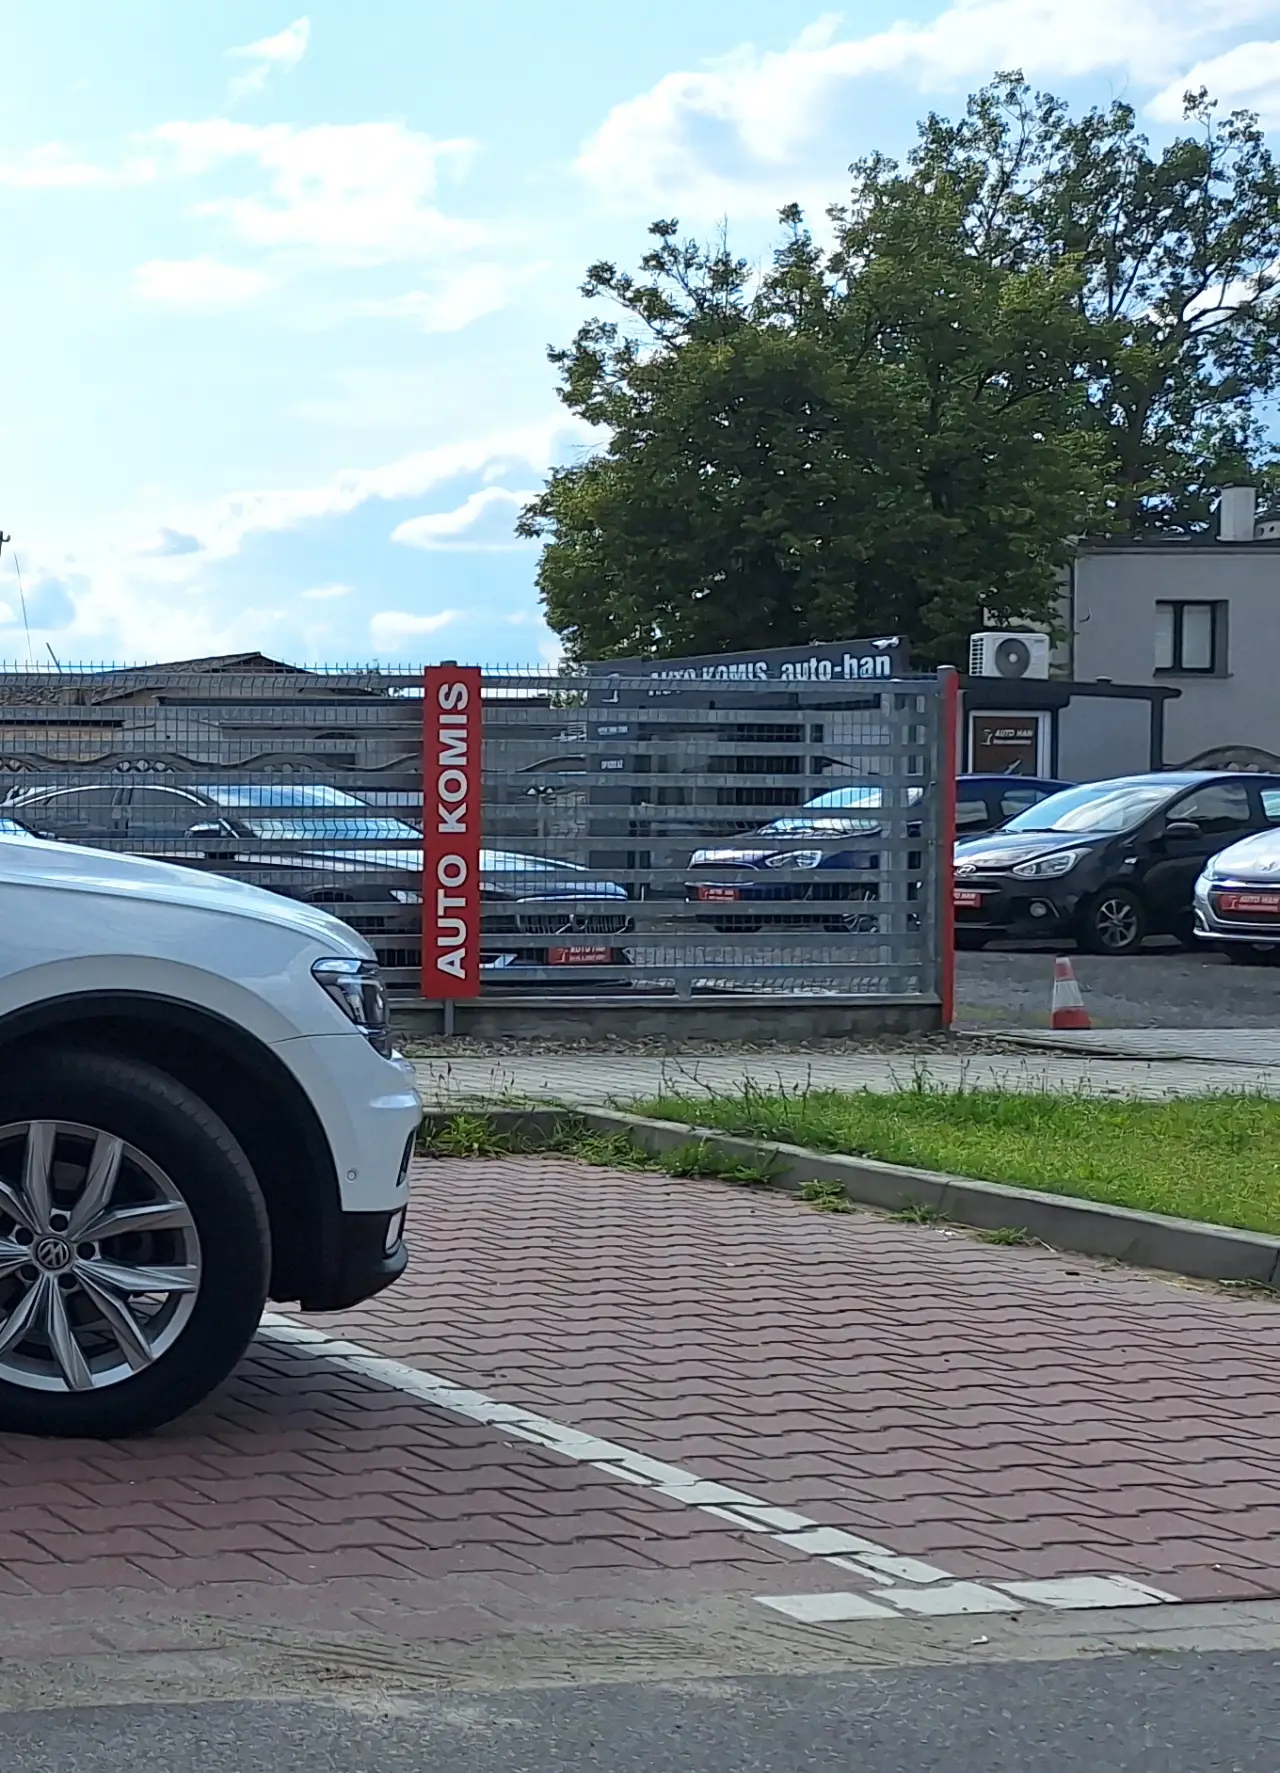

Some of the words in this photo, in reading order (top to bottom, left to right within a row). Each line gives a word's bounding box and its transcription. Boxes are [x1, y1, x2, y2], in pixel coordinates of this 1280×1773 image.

[781, 654, 891, 681] auto-han
[438, 682, 468, 833] KOMIS
[437, 854, 467, 980] AUTO
